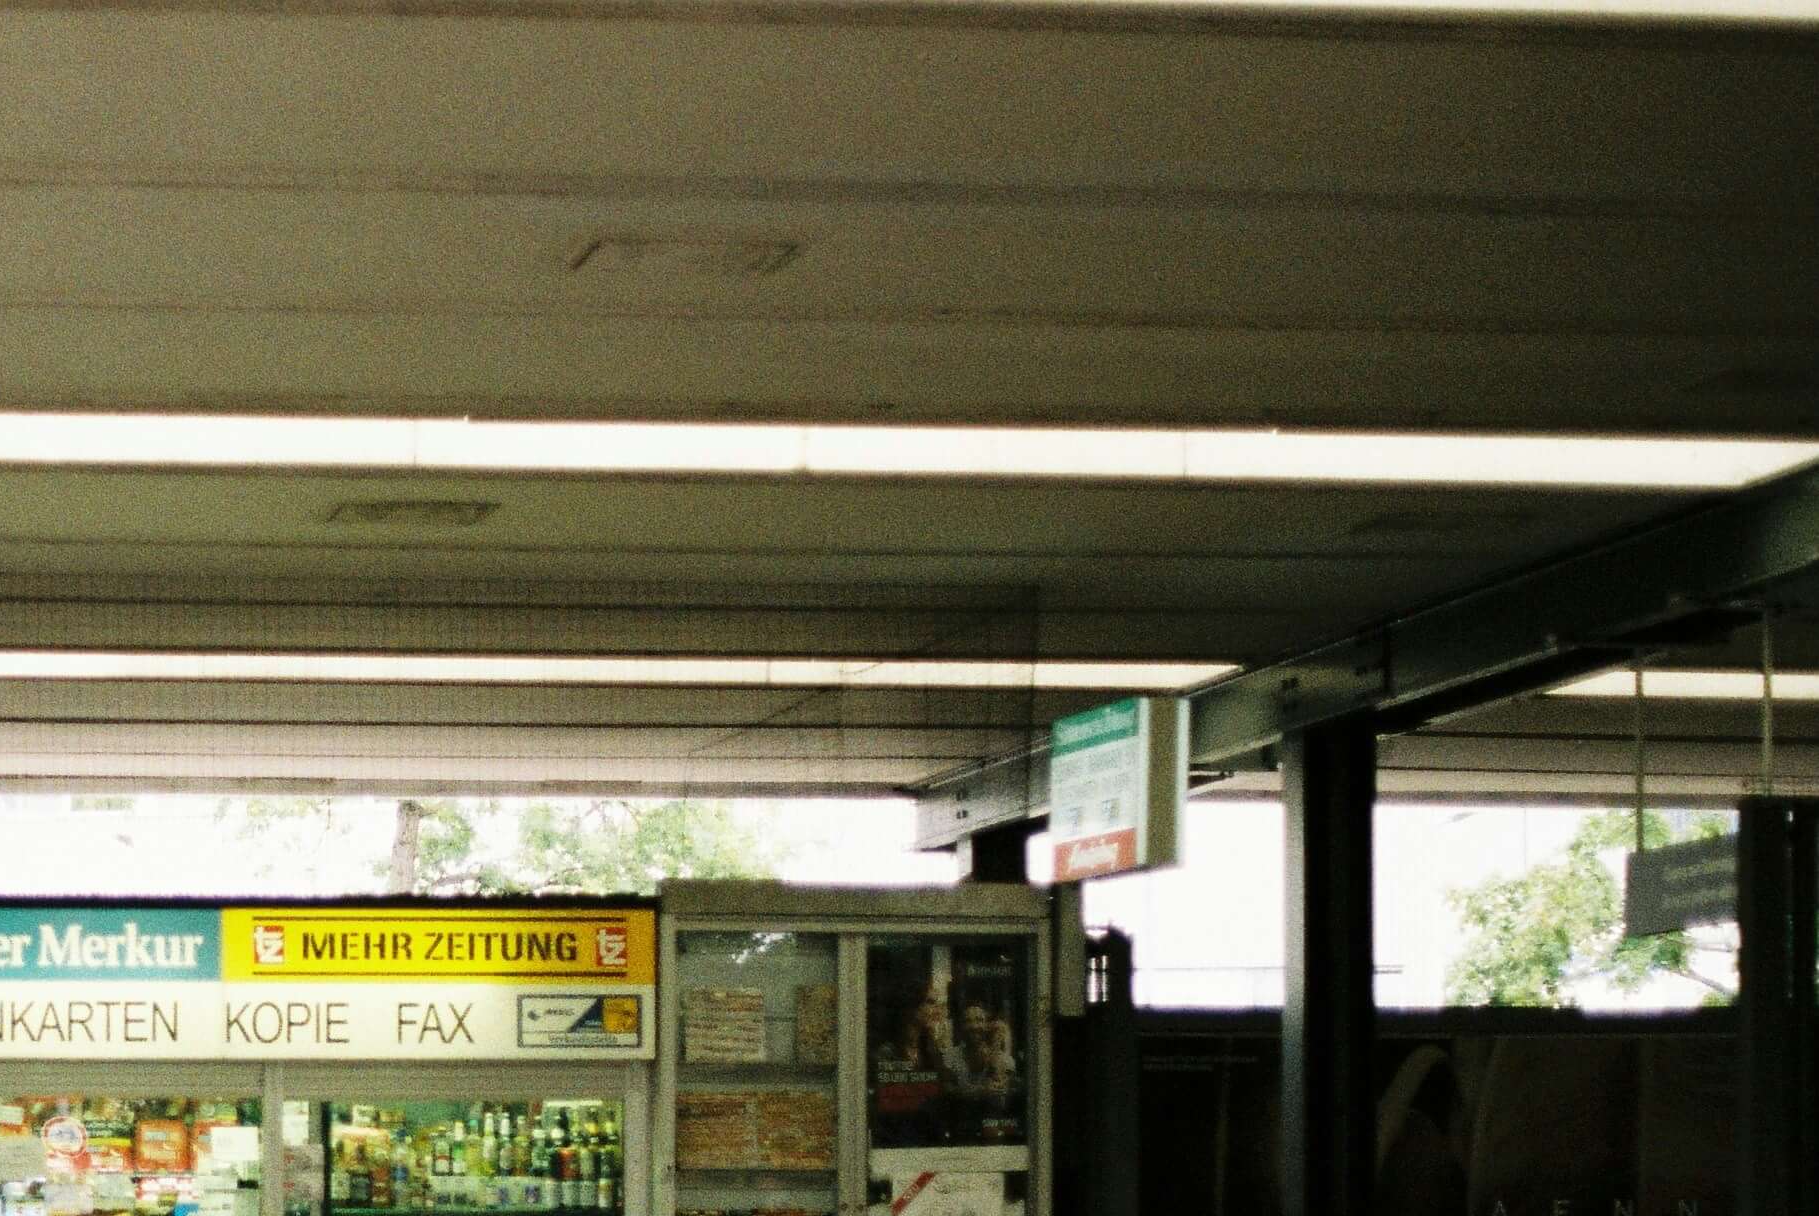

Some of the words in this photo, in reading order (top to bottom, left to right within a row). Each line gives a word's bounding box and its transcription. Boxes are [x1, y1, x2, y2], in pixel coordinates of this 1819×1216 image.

[37, 921, 204, 968] Merkur
[301, 931, 413, 961] MEHR
[424, 931, 579, 962] ZEITUNG
[225, 1001, 350, 1045] KOPIE
[397, 1002, 475, 1045] FAX
